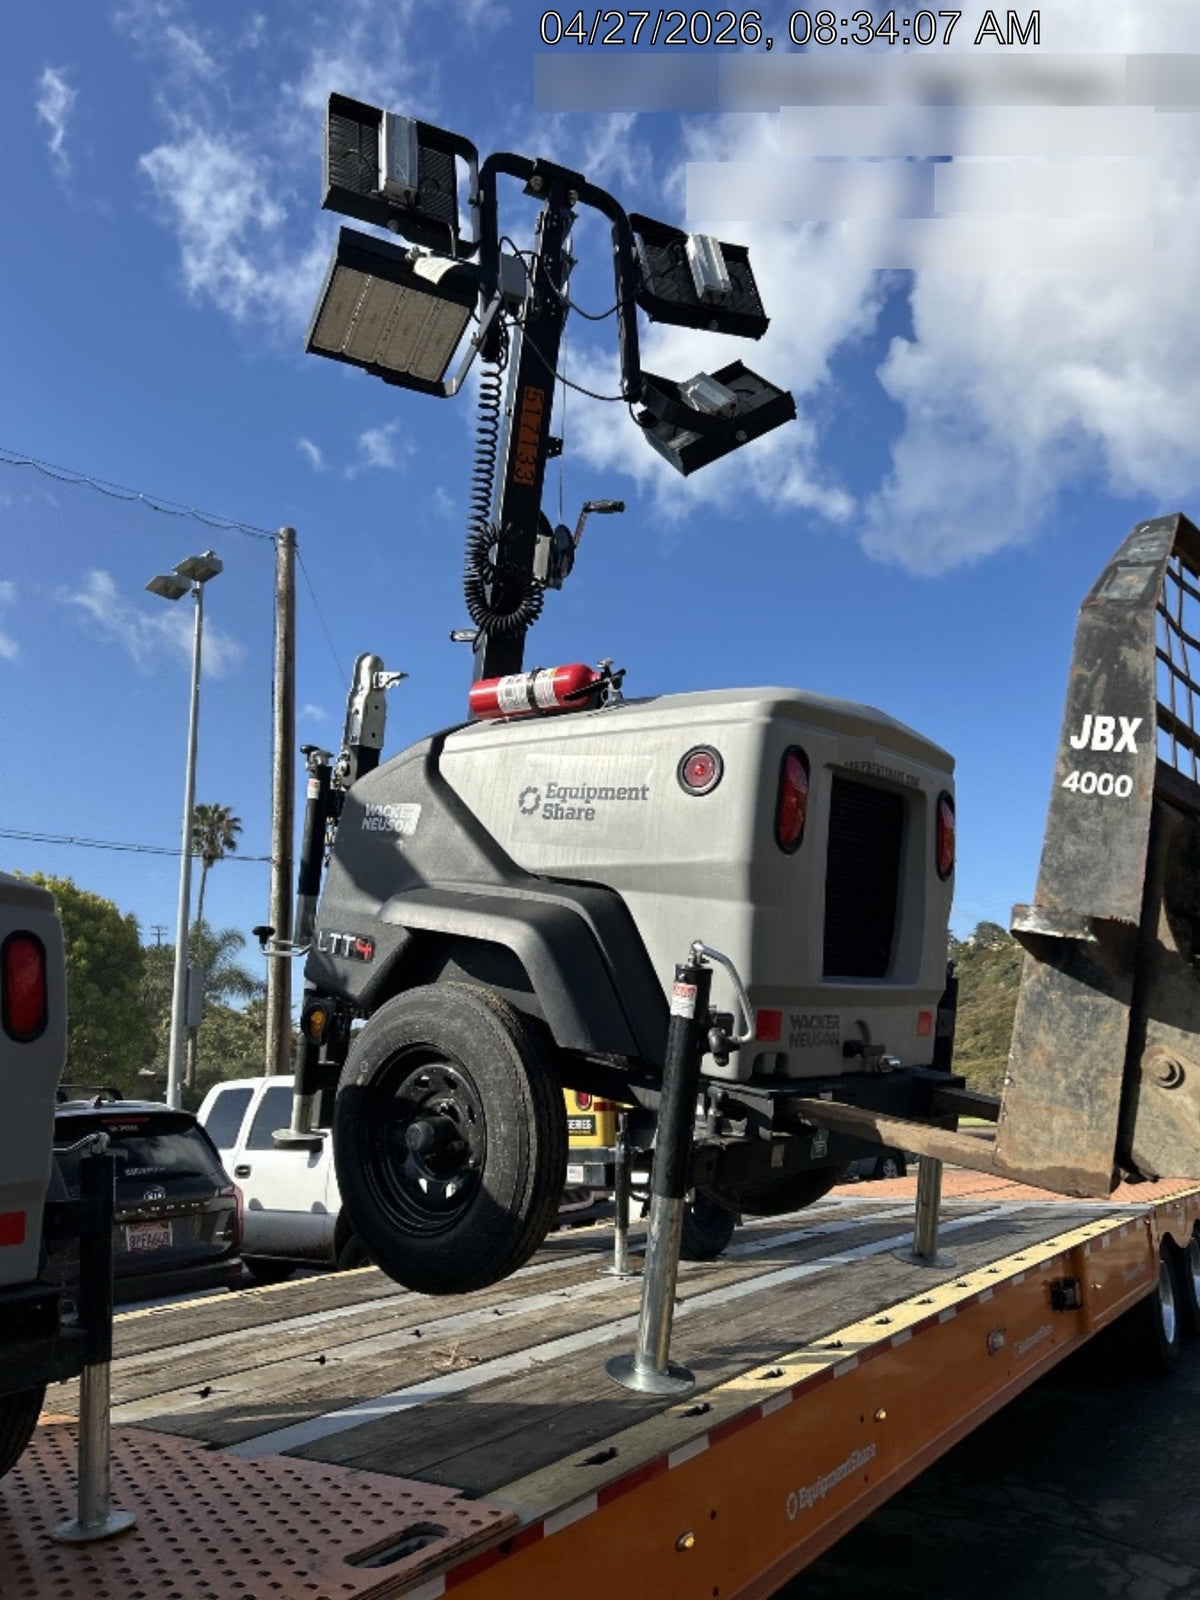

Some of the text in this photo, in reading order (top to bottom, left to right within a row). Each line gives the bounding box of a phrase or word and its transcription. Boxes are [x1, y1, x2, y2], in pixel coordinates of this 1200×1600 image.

[514, 387, 545, 482] 517133
[1070, 714, 1143, 754] JBX
[545, 782, 650, 804] Equipment
[1062, 770, 1133, 798] 4000
[541, 803, 596, 821] Share
[317, 931, 372, 961] LTT4
